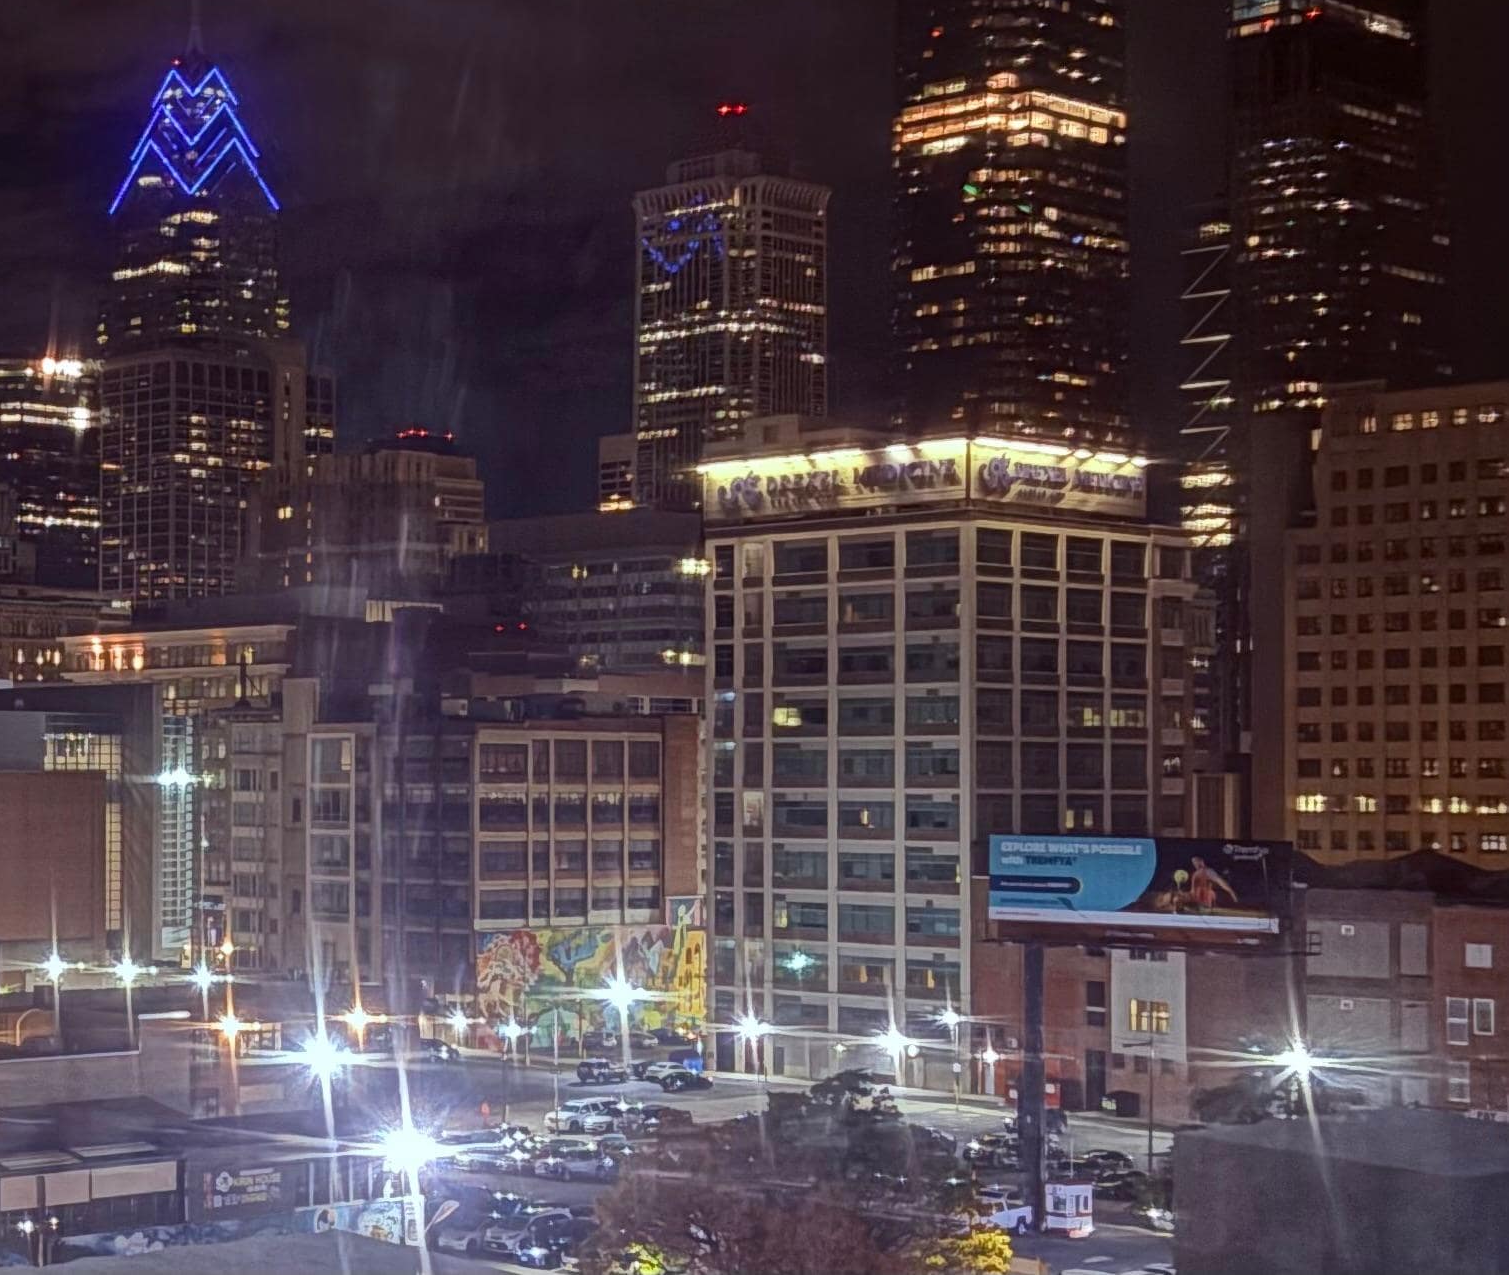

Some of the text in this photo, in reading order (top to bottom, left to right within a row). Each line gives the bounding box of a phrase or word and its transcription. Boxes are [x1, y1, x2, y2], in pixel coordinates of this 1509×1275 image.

[1000, 841, 1142, 856] EXPLORE WHAT'S POSSIBLE
